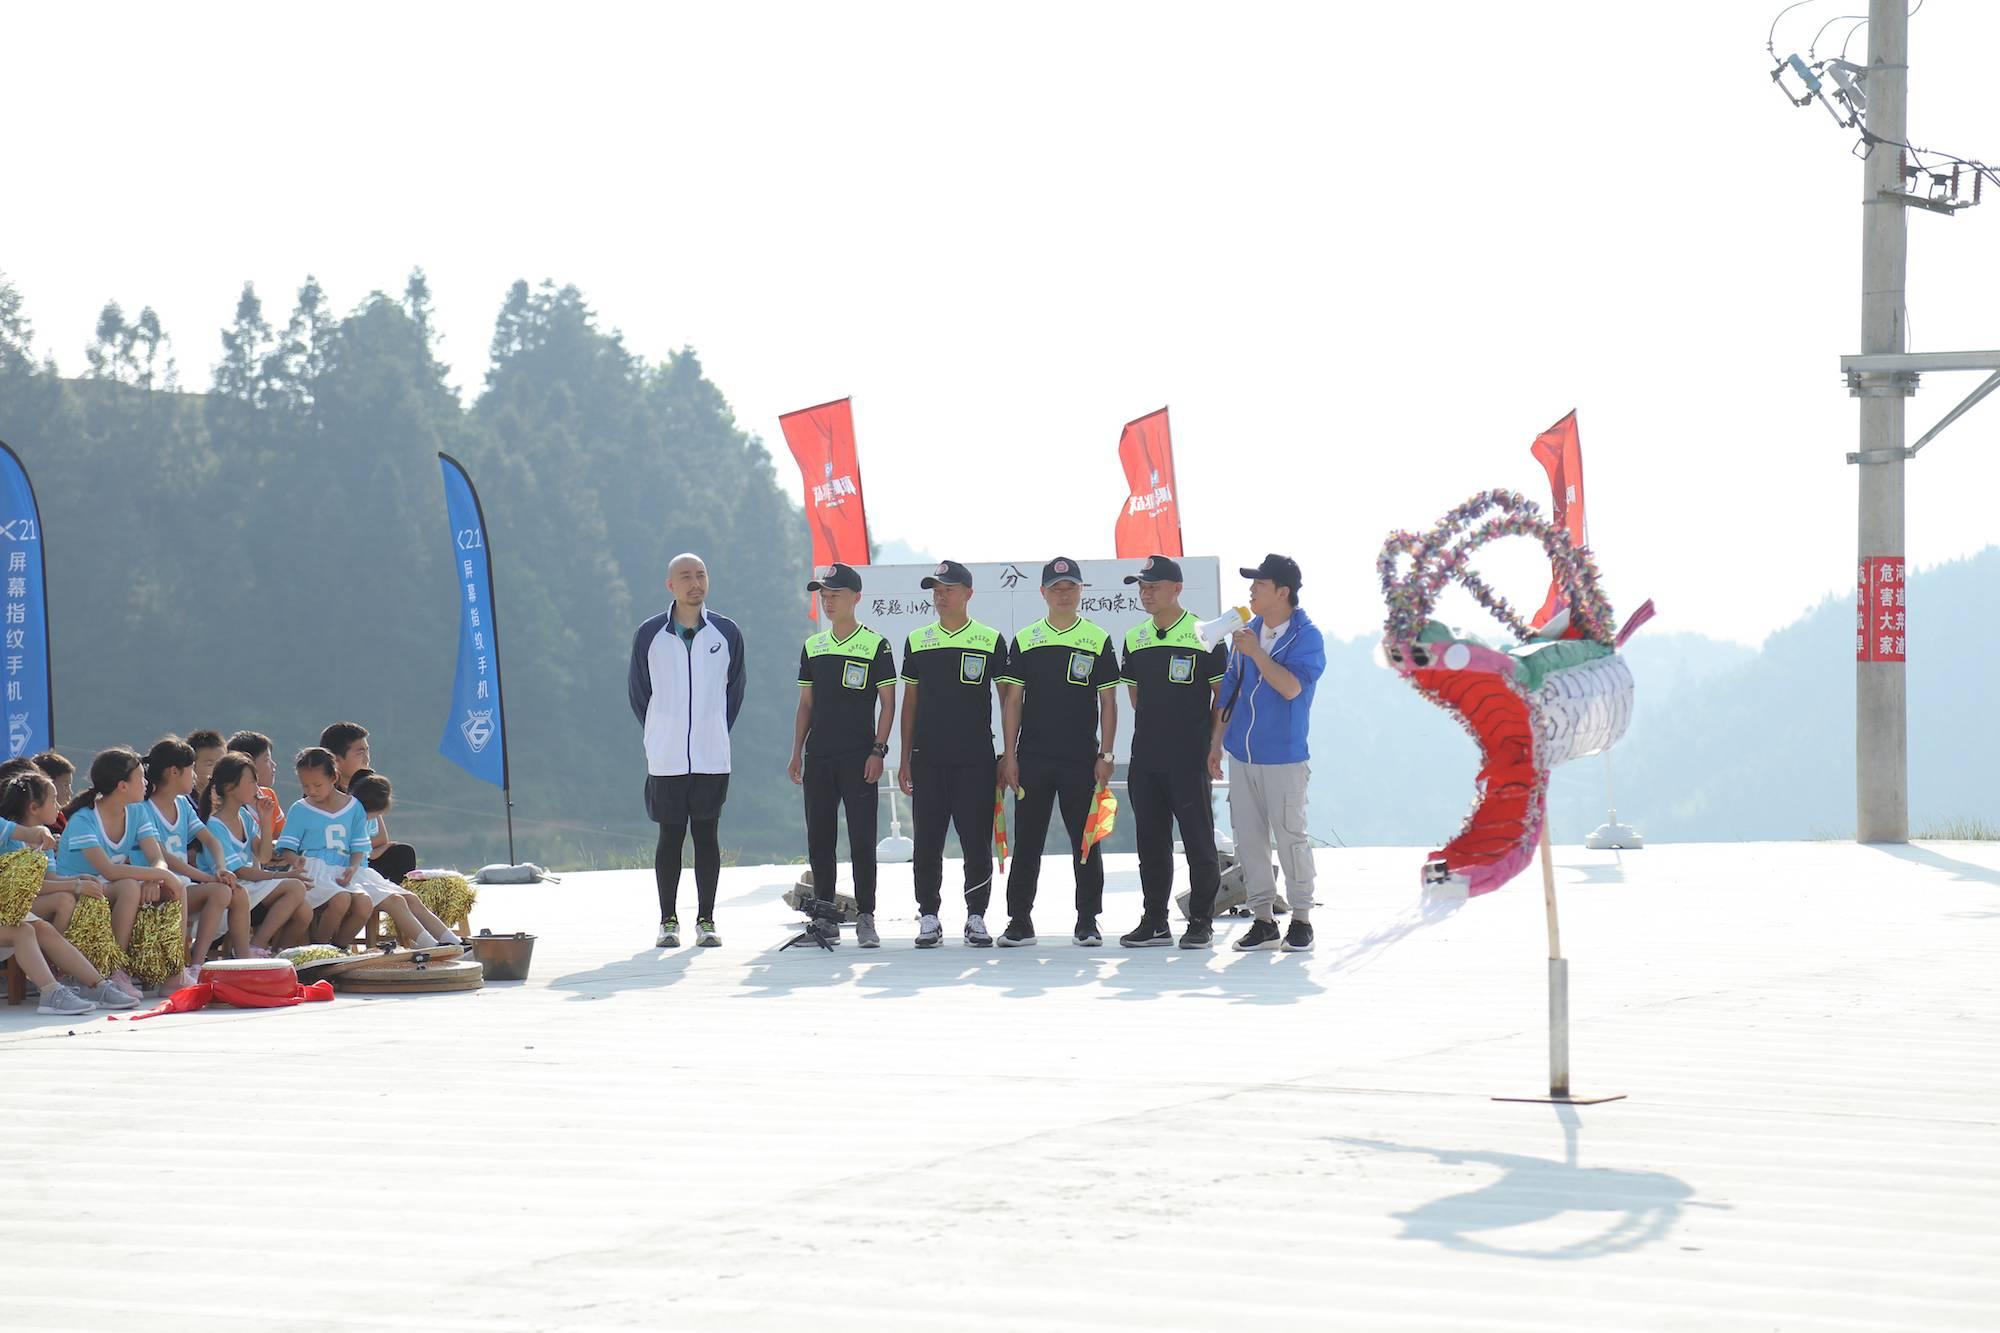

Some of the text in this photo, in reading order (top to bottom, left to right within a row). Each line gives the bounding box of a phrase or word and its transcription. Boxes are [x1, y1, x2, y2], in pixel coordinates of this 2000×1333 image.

[1000, 564, 1029, 589] 分
[1077, 592, 1146, 614] 欣向荣队
[6, 551, 27, 702] 屏幕指纹手机
[464, 559, 489, 700] 屏幕指纹手机
[872, 599, 937, 617] 答题小分
[1880, 563, 1894, 655] 危害大家
